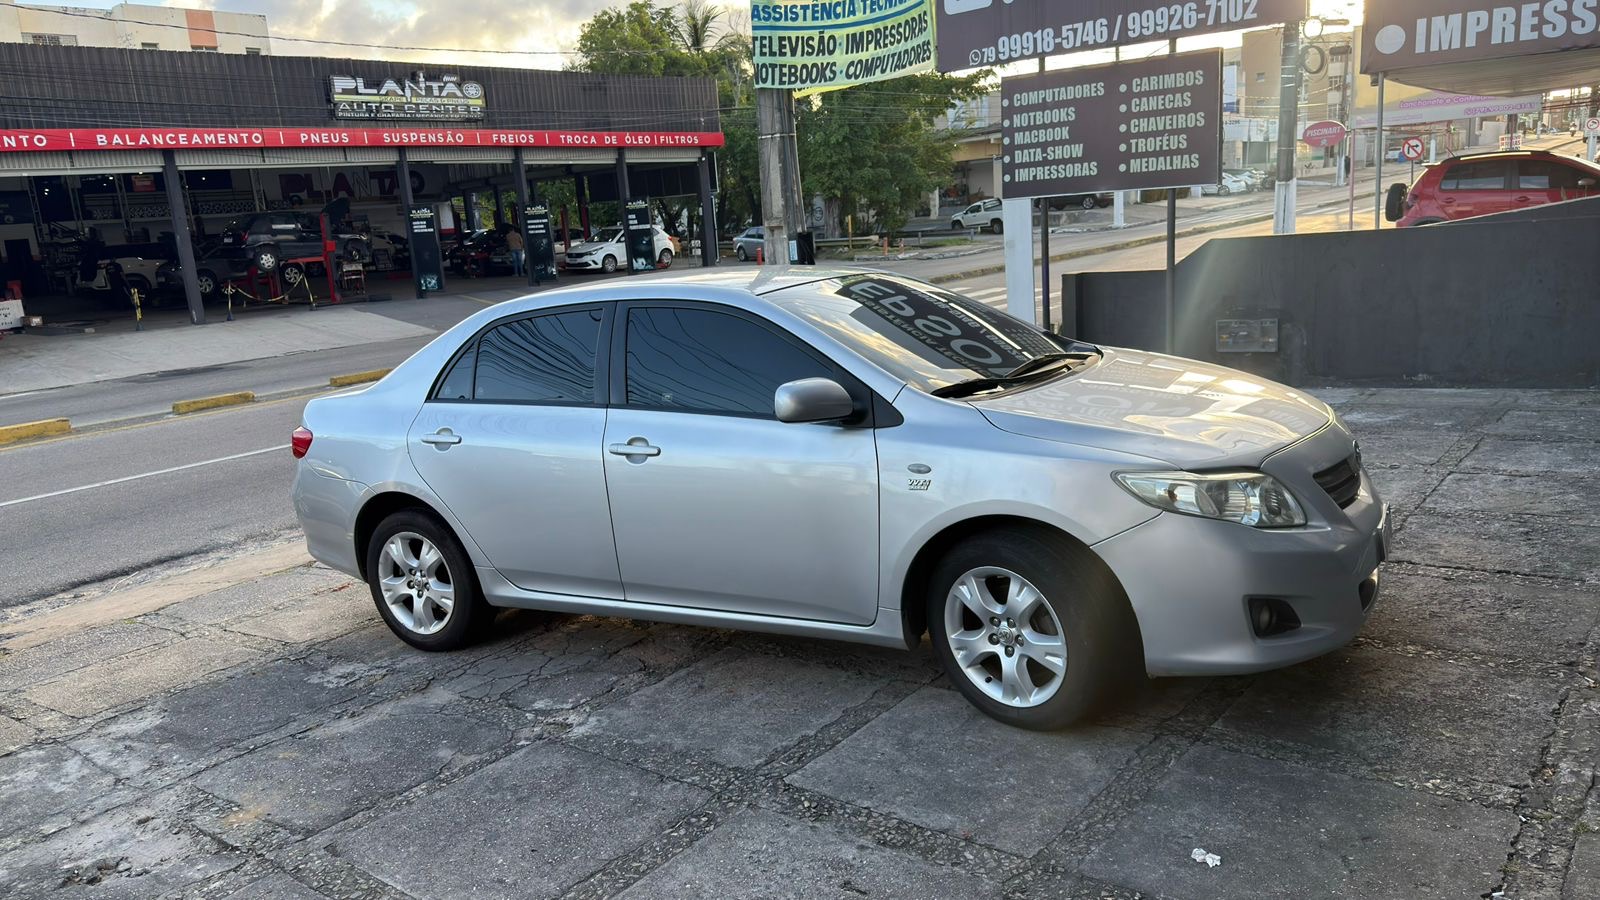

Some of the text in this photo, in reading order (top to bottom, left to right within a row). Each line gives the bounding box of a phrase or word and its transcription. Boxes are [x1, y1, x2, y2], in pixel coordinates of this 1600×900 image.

[751, 0, 857, 22] ASSISTÊNCIA
[752, 10, 928, 57] TELEVISÃO IMPRESSORAS
[982, 46, 996, 63] 79
[998, 17, 1108, 60] 99918-5746
[1127, 0, 1257, 38] 99926-7102
[1414, 0, 1600, 54] IMPRESS
[753, 39, 931, 86] NOTEBOOKS COMPUTADORES
[1132, 70, 1204, 93] CARIMBOS
[1013, 82, 1105, 107] COMPUTADORES
[1131, 92, 1192, 112] CANECAS
[338, 102, 481, 115] AUTO CENTER
[1013, 107, 1076, 128] NOTBOOKS
[1130, 112, 1205, 134] CHAVEIROS
[0, 131, 699, 148] NTO BALANCEAMENTO PNEUS SUSPENSÃO FREIOS TROCA DE ÓLEO FILTROS
[1014, 127, 1069, 145] MACBOOK
[1130, 134, 1187, 153] TROFÉUS
[1014, 143, 1084, 163] DATA-SHOW
[1130, 153, 1200, 173] MEDALHAS
[1015, 162, 1098, 182] IMPRESSORAS
